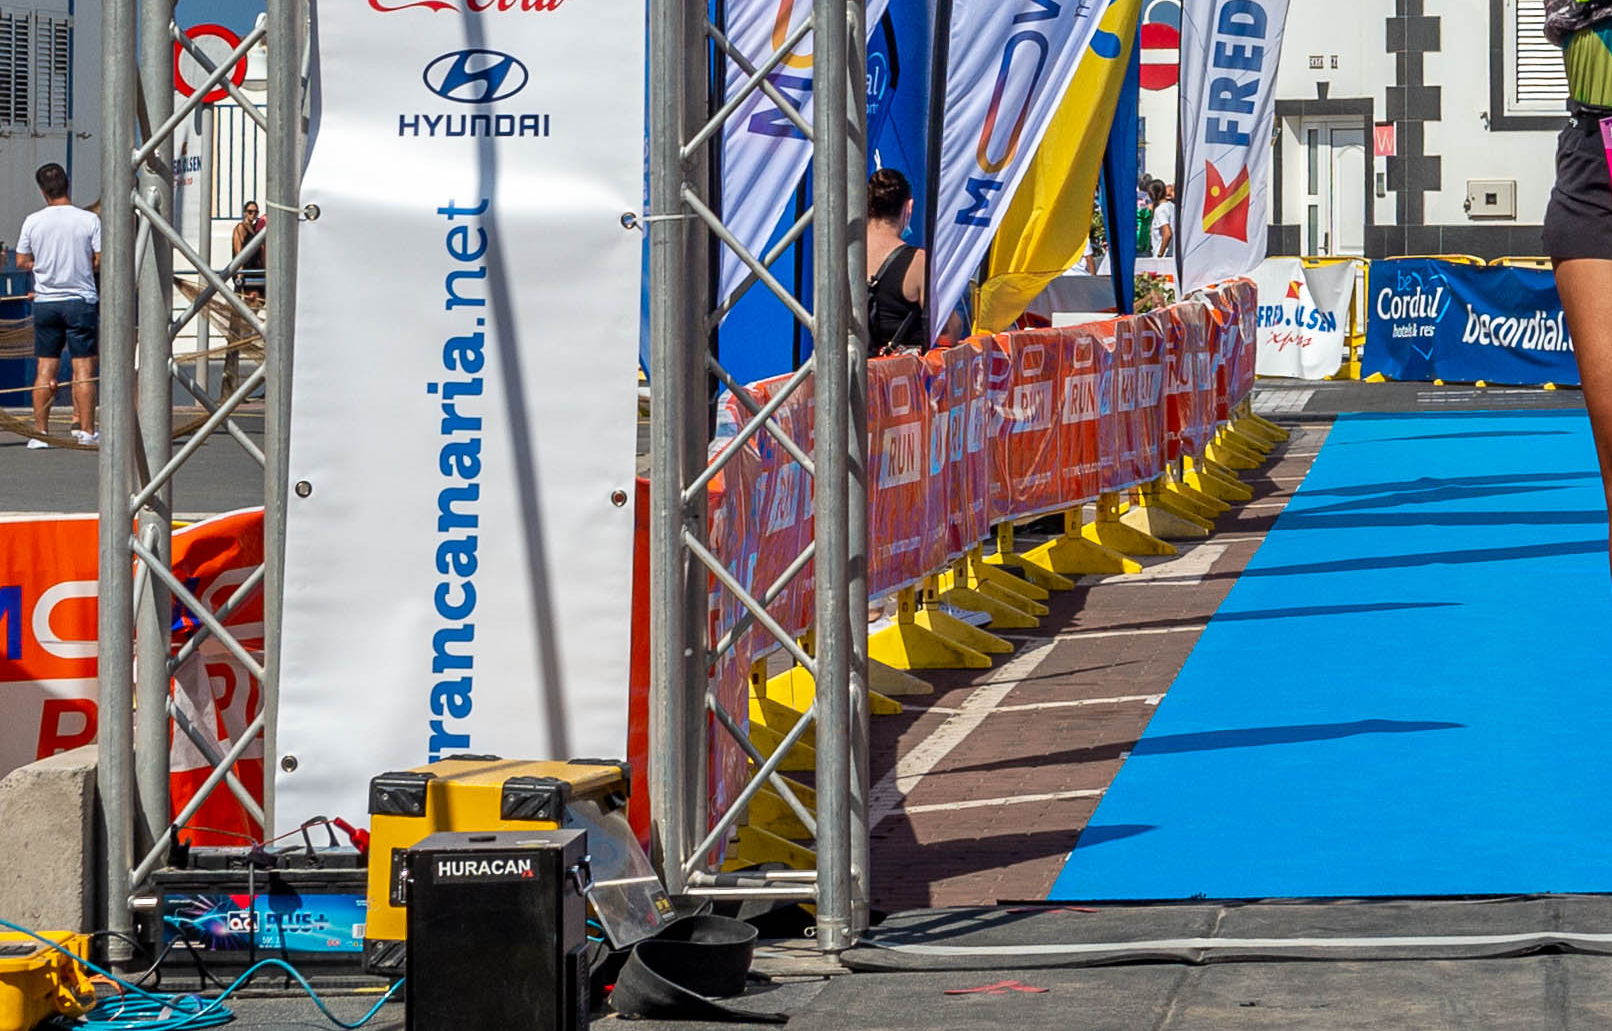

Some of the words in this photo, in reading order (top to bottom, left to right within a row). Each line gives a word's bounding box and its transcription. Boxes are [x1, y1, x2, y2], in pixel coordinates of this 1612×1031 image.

[399, 114, 550, 137] HYUNDAI
[1070, 381, 1095, 416] RUN
[888, 432, 915, 477] RUN
[427, 197, 489, 763] rancanaria.net
[437, 859, 531, 877] HURACAN
